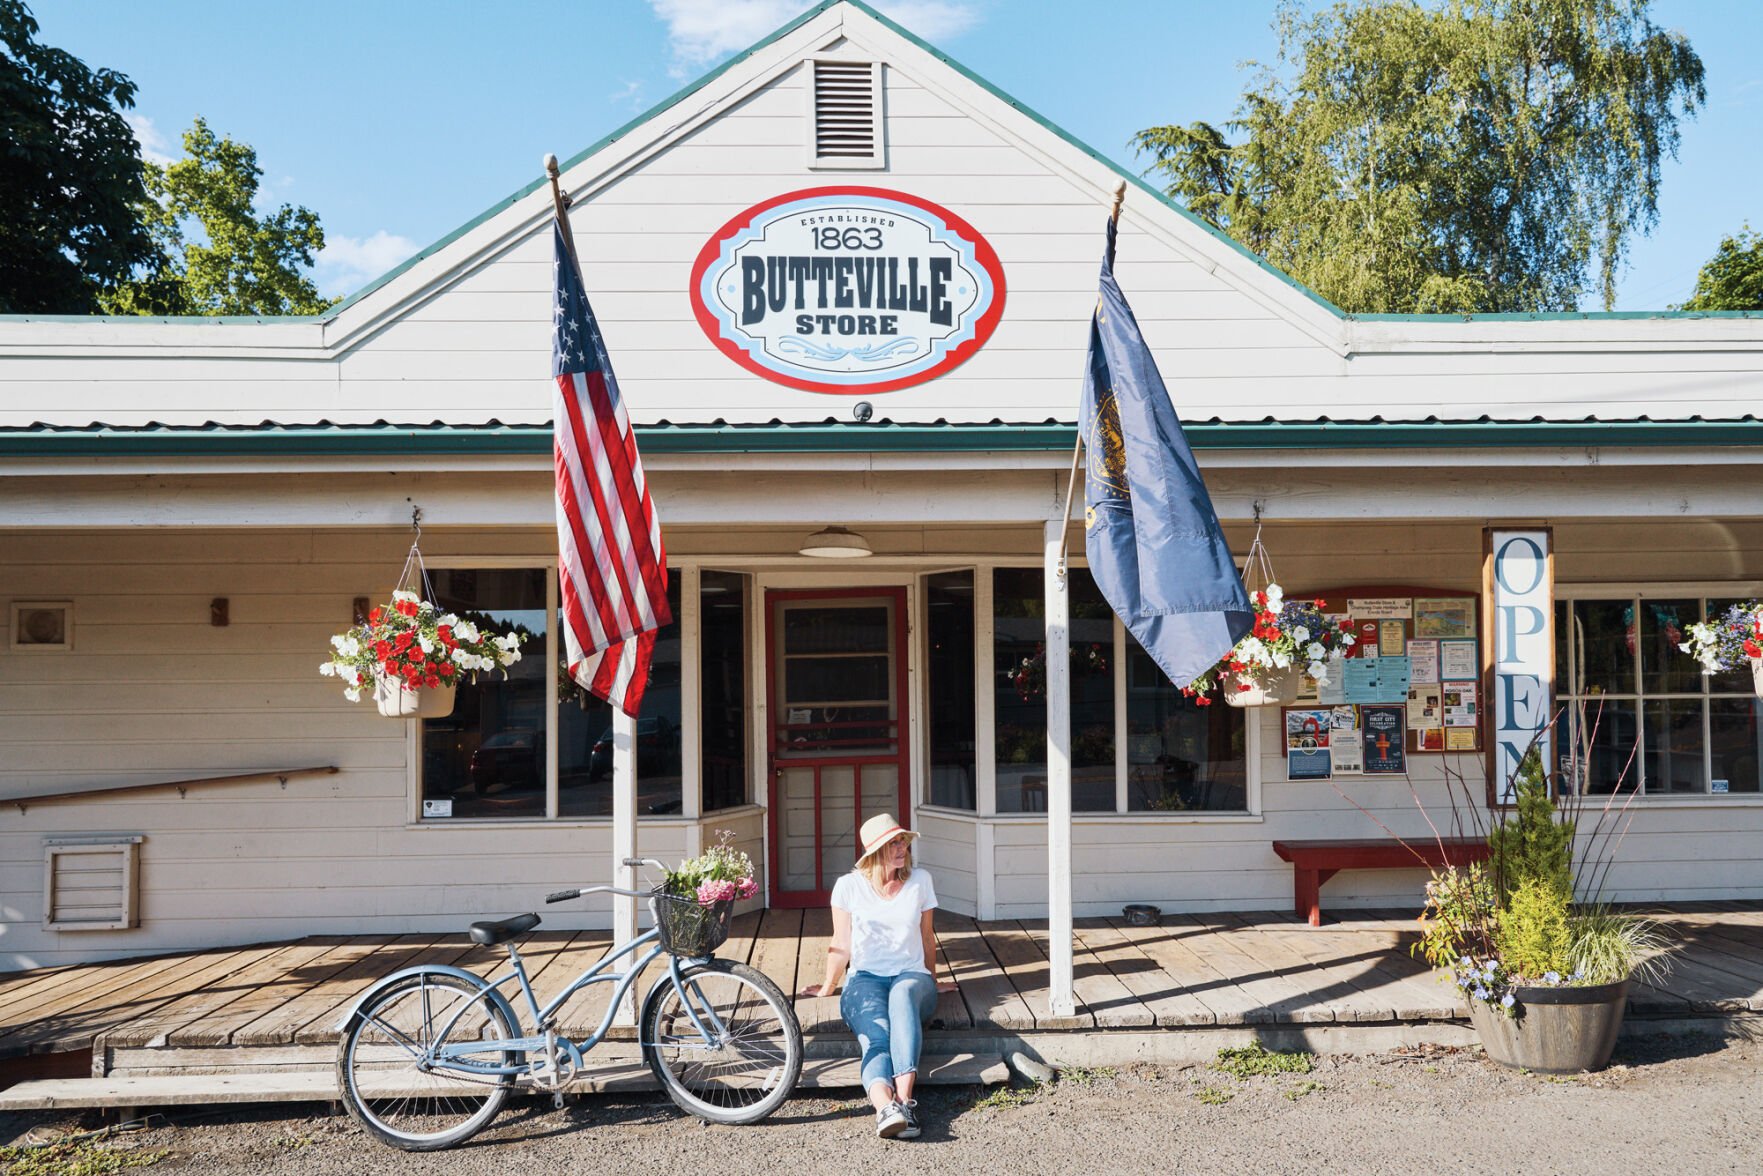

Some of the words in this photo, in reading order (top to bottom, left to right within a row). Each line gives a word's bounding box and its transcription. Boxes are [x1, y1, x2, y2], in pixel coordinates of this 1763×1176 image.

[801, 215, 895, 227] ESTABLISHED
[811, 227, 883, 250] 1863
[741, 255, 952, 327] BUTTEVILLE
[796, 314, 898, 335] STORE
